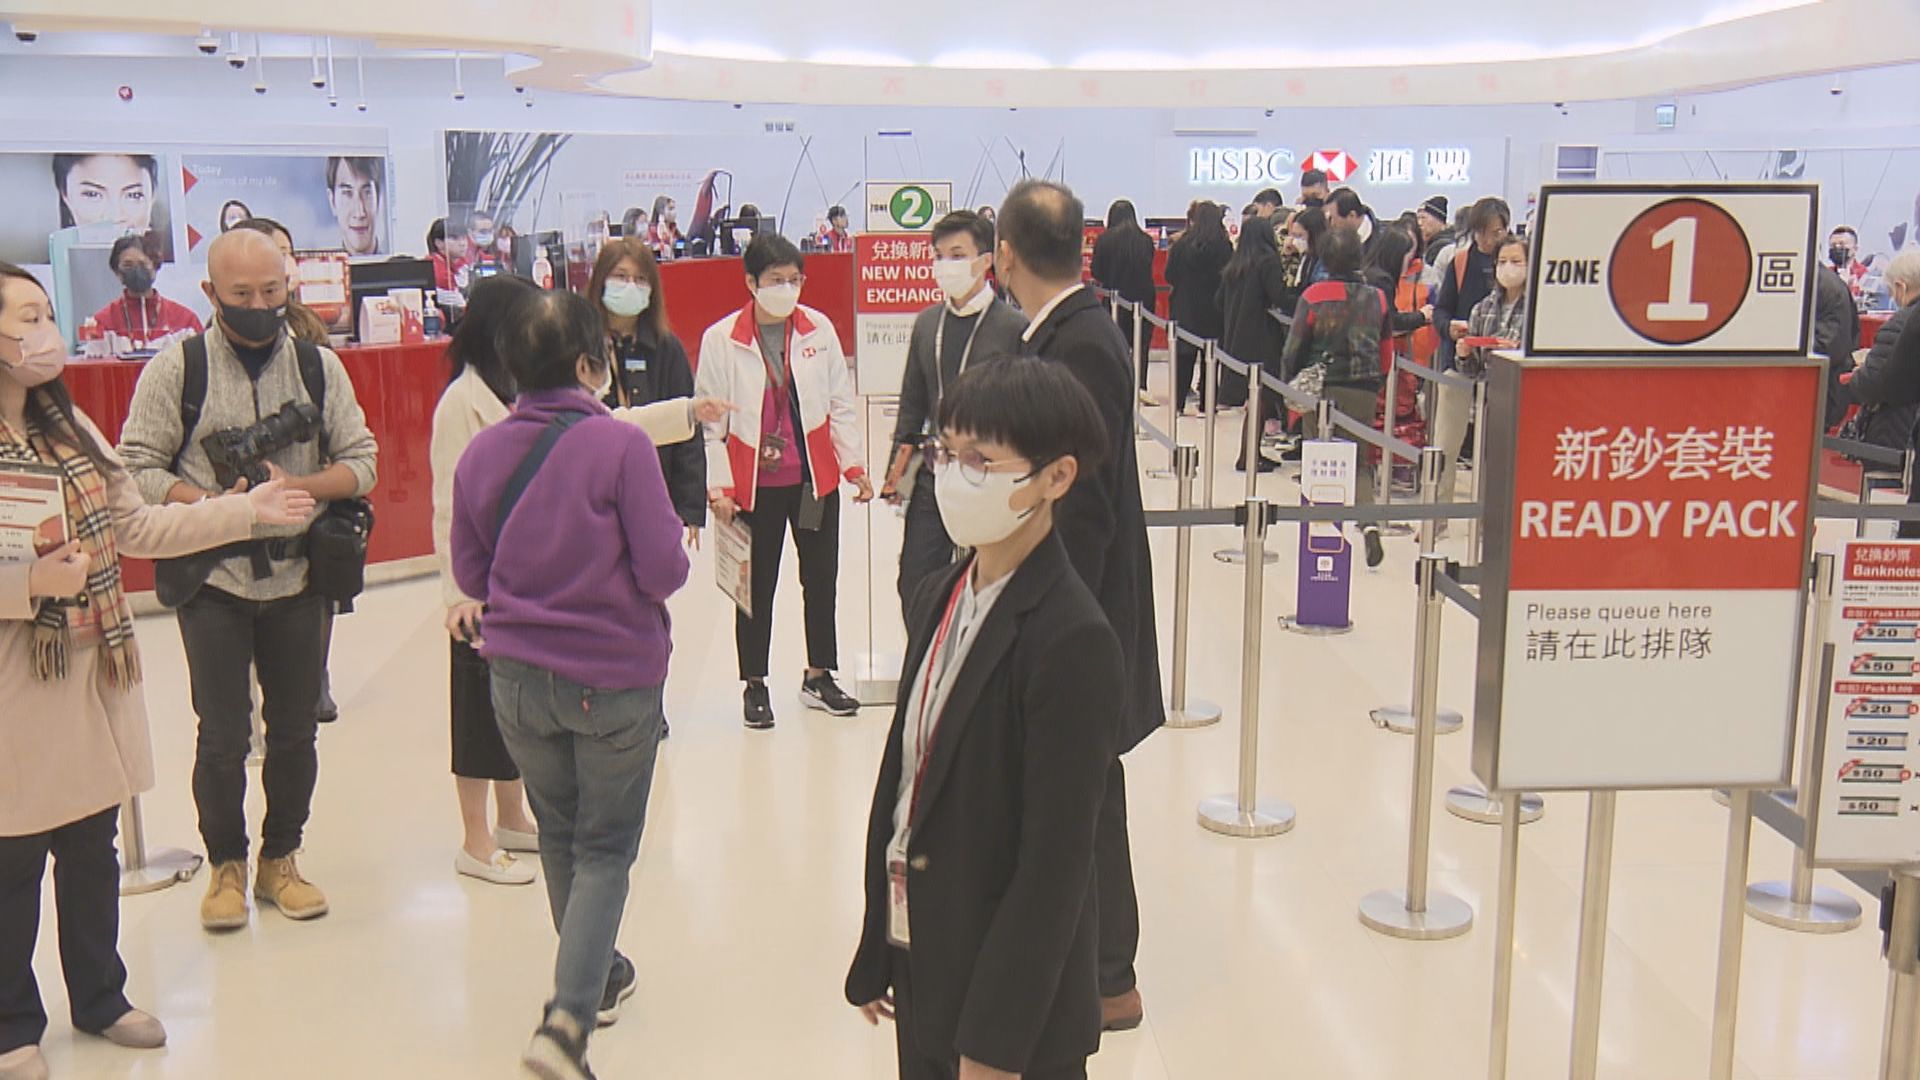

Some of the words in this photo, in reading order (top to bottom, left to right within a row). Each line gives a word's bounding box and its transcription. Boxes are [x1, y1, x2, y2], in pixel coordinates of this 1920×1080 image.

[1190, 149, 1294, 182] HSBC
[900, 189, 924, 223] 2
[862, 266, 901, 281] NEW
[904, 265, 936, 280] NOT
[1544, 259, 1600, 285] ZONE
[1646, 216, 1708, 321] 1
[1756, 251, 1799, 293] 區
[866, 331, 910, 345] 請在此
[1552, 426, 1775, 482] 新鈔套裝
[1519, 500, 1671, 538] READY
[1683, 499, 1799, 538] PACK
[1526, 604, 1590, 620] Please
[1598, 606, 1660, 624] queue
[1668, 602, 1712, 619] here
[1525, 628, 1713, 662] 請在此排隊
